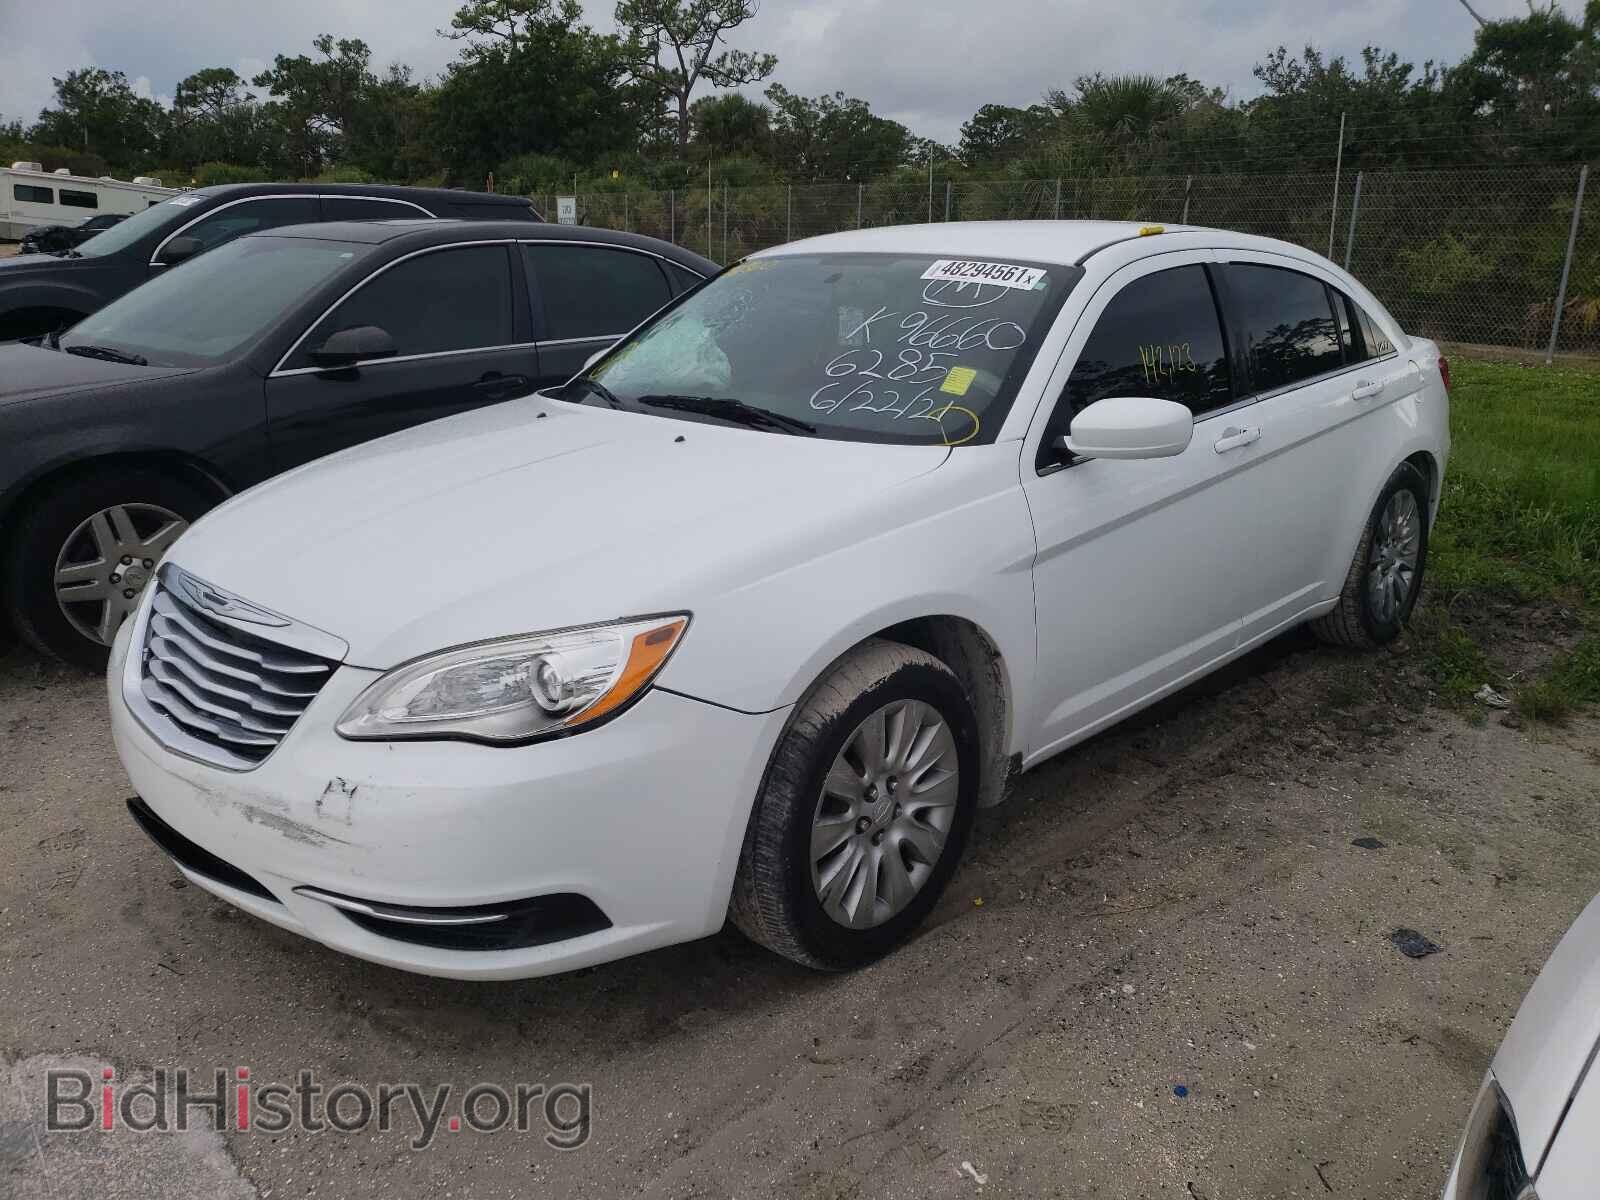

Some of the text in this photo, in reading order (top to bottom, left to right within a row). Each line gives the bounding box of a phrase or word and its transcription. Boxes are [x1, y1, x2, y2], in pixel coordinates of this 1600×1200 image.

[846, 306, 897, 343] K
[898, 312, 1026, 350] 96660
[825, 349, 959, 384] 6285
